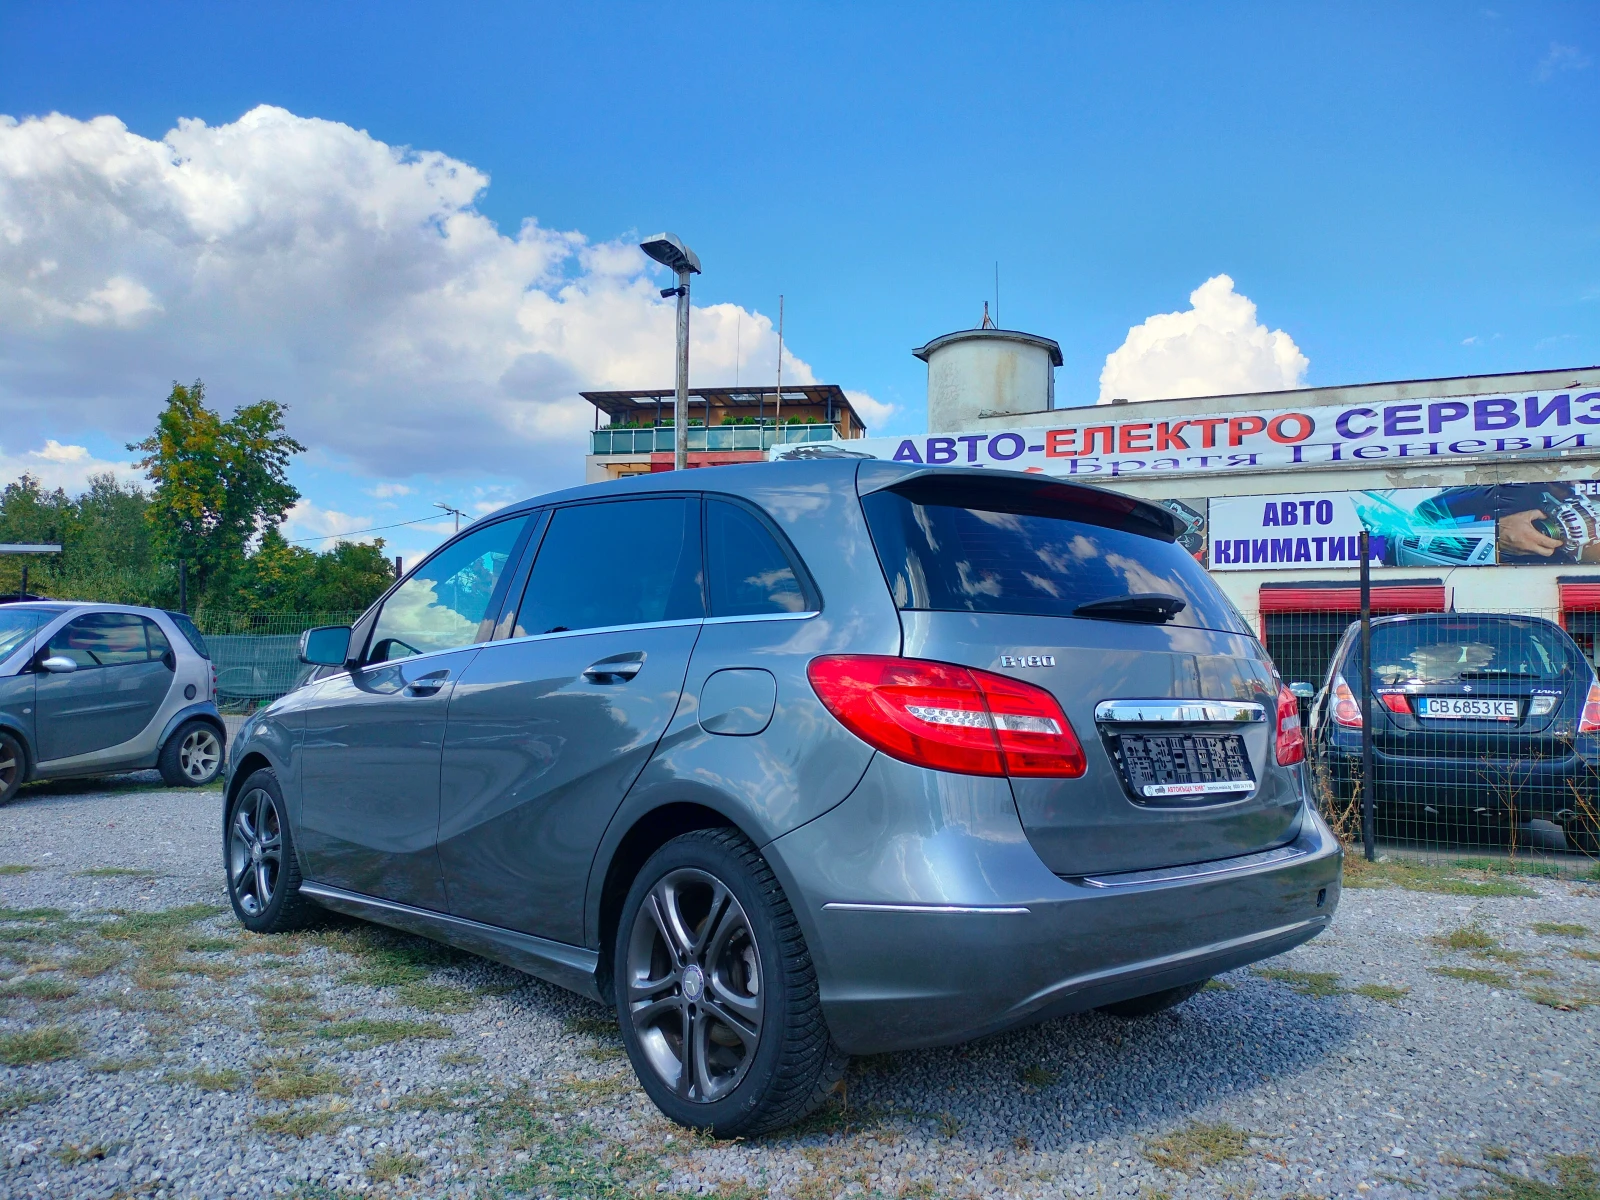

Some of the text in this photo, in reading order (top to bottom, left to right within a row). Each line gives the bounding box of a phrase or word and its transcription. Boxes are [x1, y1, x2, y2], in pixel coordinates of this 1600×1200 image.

[892, 413, 1315, 465] АВТО-ЕЛЕКТРО
[1065, 432, 1593, 477] Братя Пеневи
[1574, 482, 1600, 496] РЕ
[1262, 499, 1334, 527] АВТО
[1000, 655, 1056, 668] B180
[1429, 700, 1515, 715] CB 6853 KE
